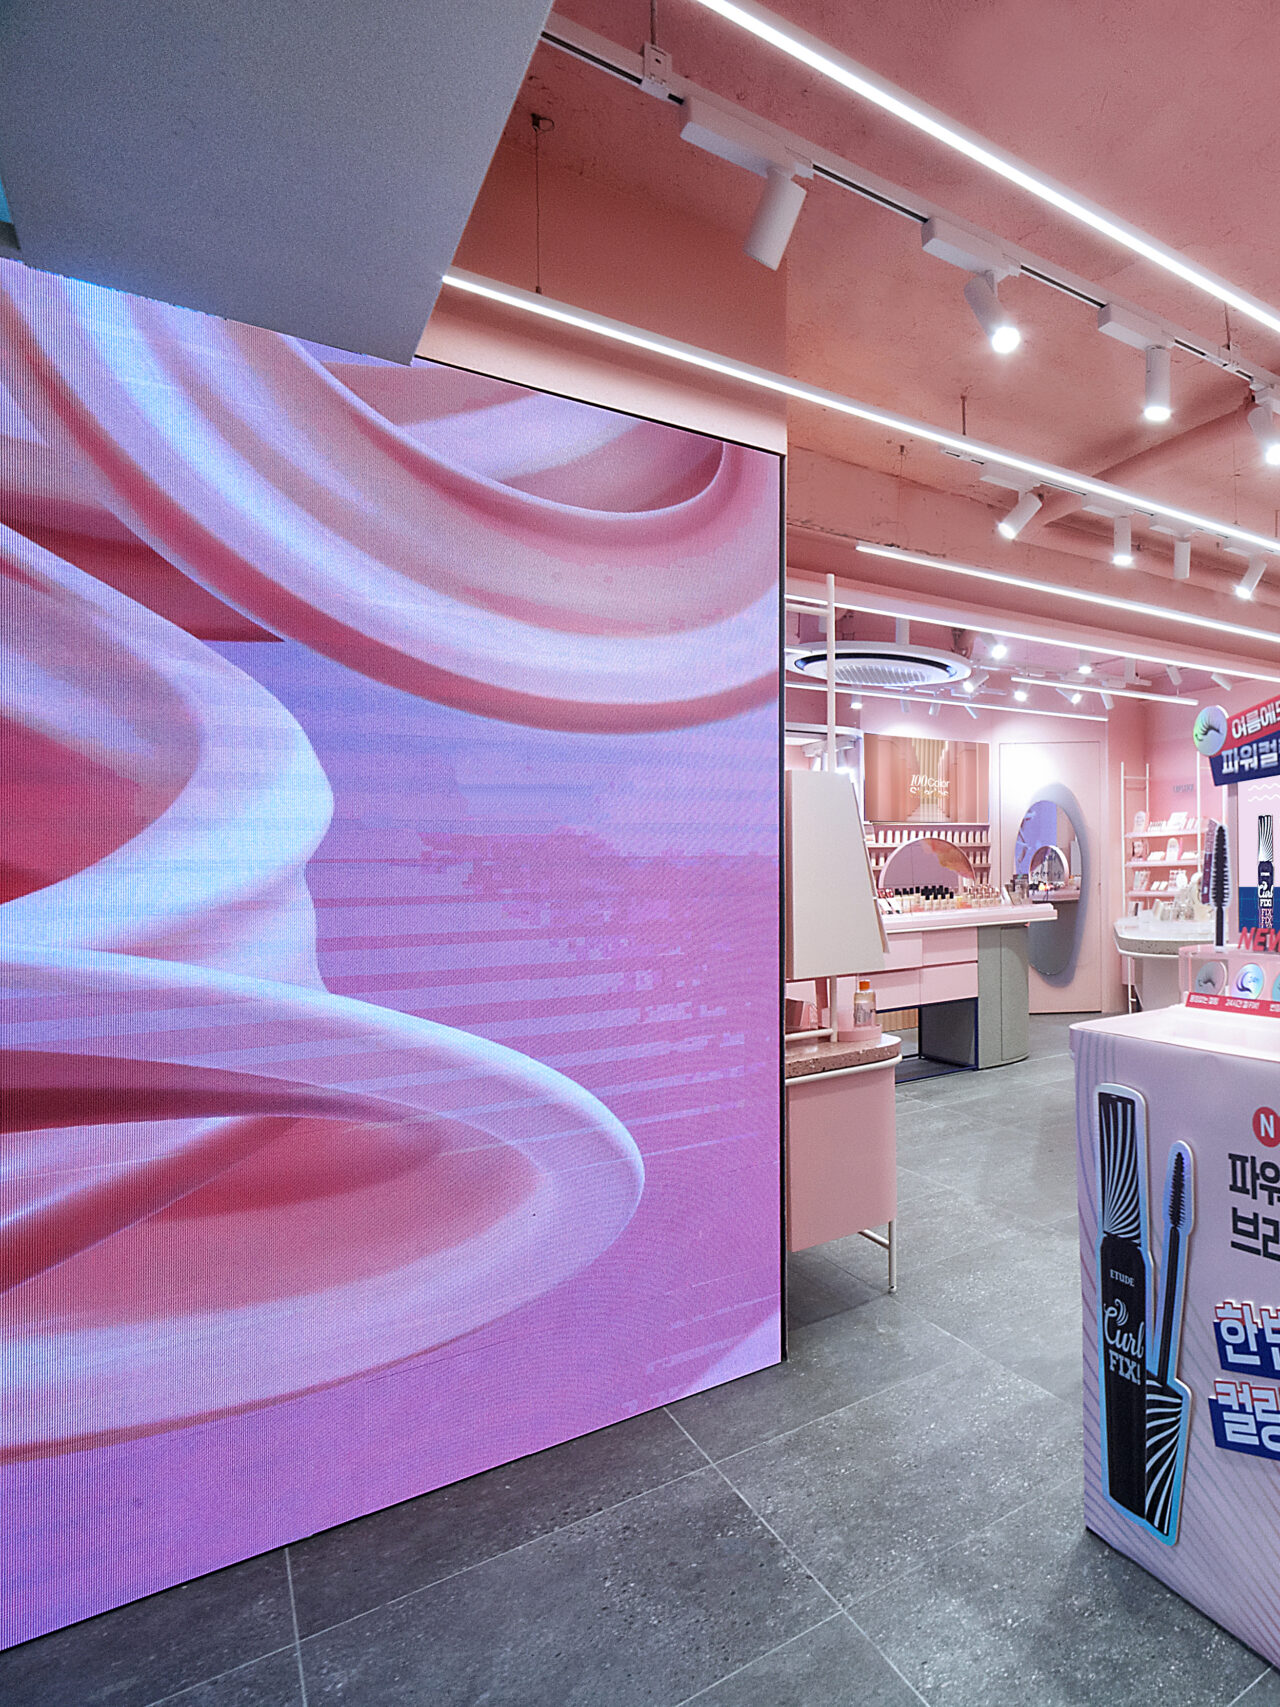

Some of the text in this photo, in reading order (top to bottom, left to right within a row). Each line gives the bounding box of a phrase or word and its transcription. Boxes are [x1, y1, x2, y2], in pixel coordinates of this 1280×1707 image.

[1109, 1268, 1135, 1287] ETUDE
[1103, 1300, 1145, 1358] Curl
[1108, 1348, 1142, 1386] FIX!
